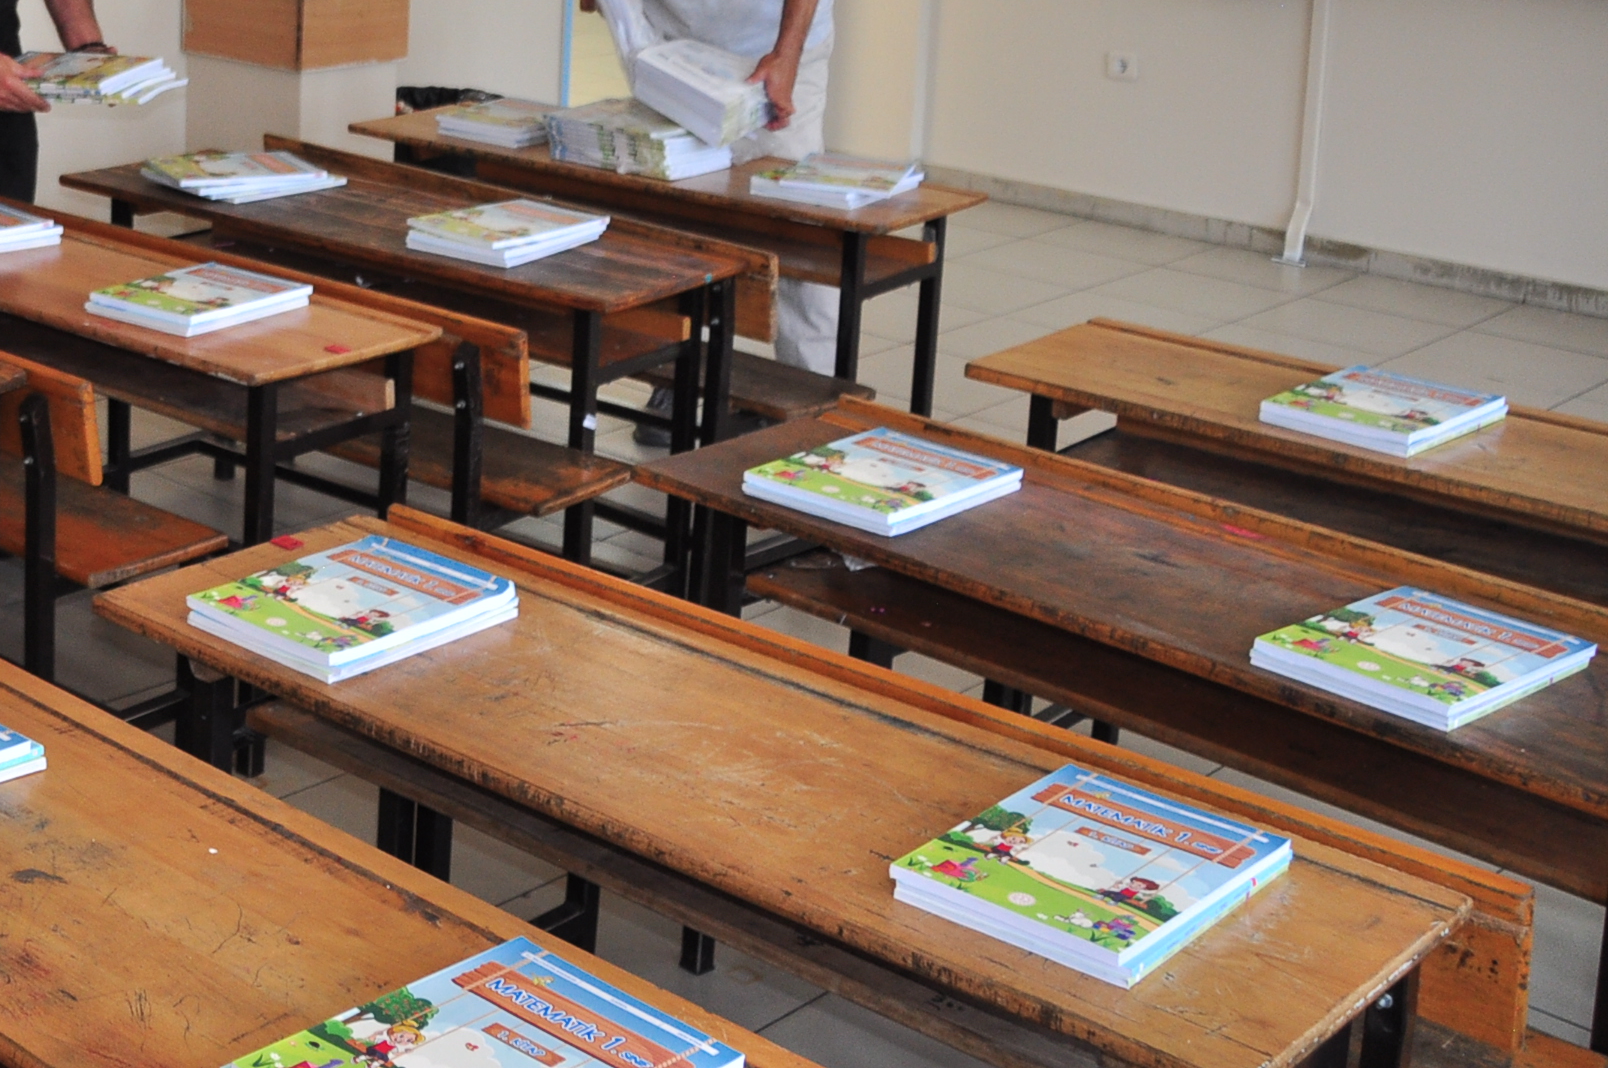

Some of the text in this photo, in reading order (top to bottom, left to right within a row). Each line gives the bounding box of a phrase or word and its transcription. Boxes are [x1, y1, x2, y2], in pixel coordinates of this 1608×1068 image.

[1060, 793, 1173, 838] MATEMATİK
[486, 977, 606, 1043] MATEMATİK
[601, 1035, 627, 1055] 1.
